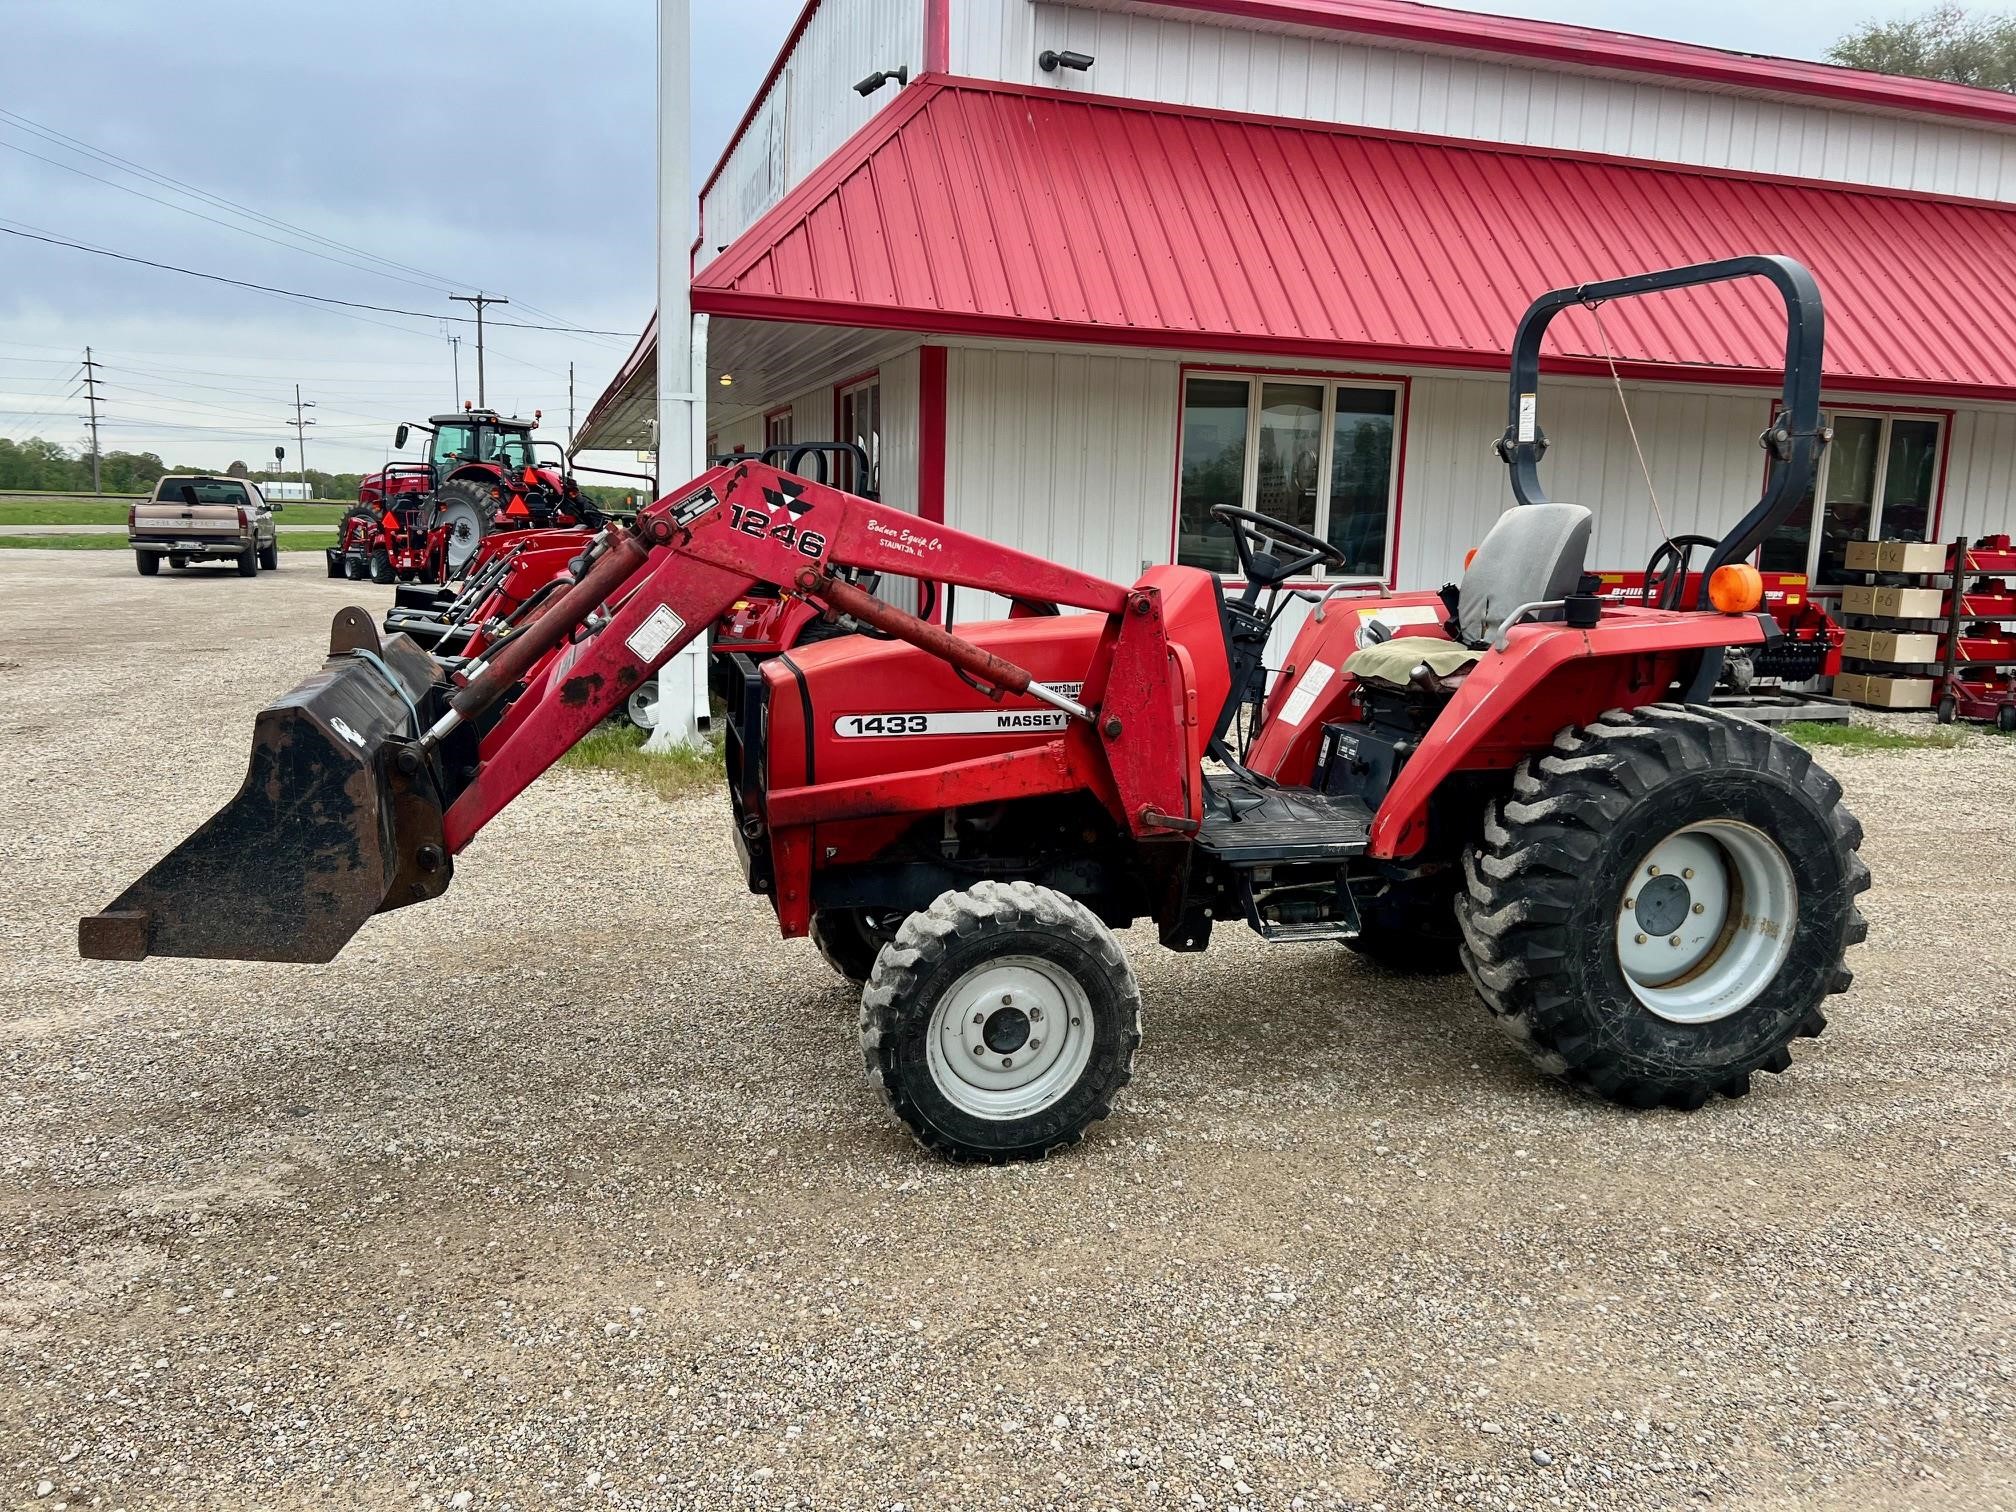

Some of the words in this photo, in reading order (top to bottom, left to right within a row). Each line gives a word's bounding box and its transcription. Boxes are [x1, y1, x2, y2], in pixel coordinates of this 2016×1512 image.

[730, 503, 826, 559] 1246
[867, 519, 897, 537] Bodner
[1611, 588, 1657, 596] Brillin
[850, 716, 927, 734] 1433
[997, 714, 1063, 727] MASSEY
